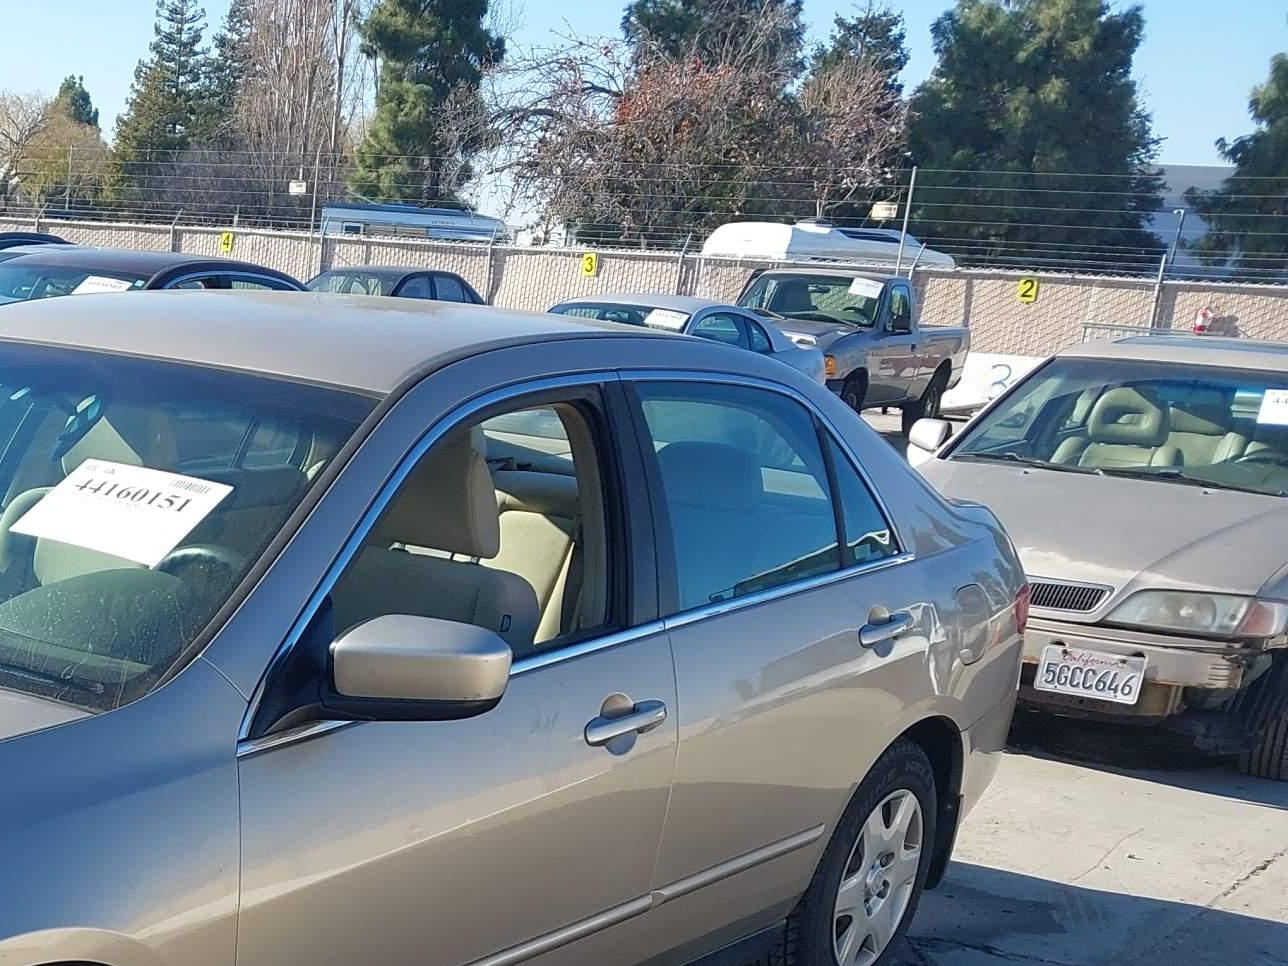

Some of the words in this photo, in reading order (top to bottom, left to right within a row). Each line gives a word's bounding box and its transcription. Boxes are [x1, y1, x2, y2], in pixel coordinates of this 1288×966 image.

[222, 234, 231, 249] 4
[585, 256, 594, 273] 3
[1020, 279, 1035, 298] 2
[74, 478, 193, 512] 44160151
[1062, 650, 1125, 669] California
[1043, 661, 1137, 697] 5GCC646
